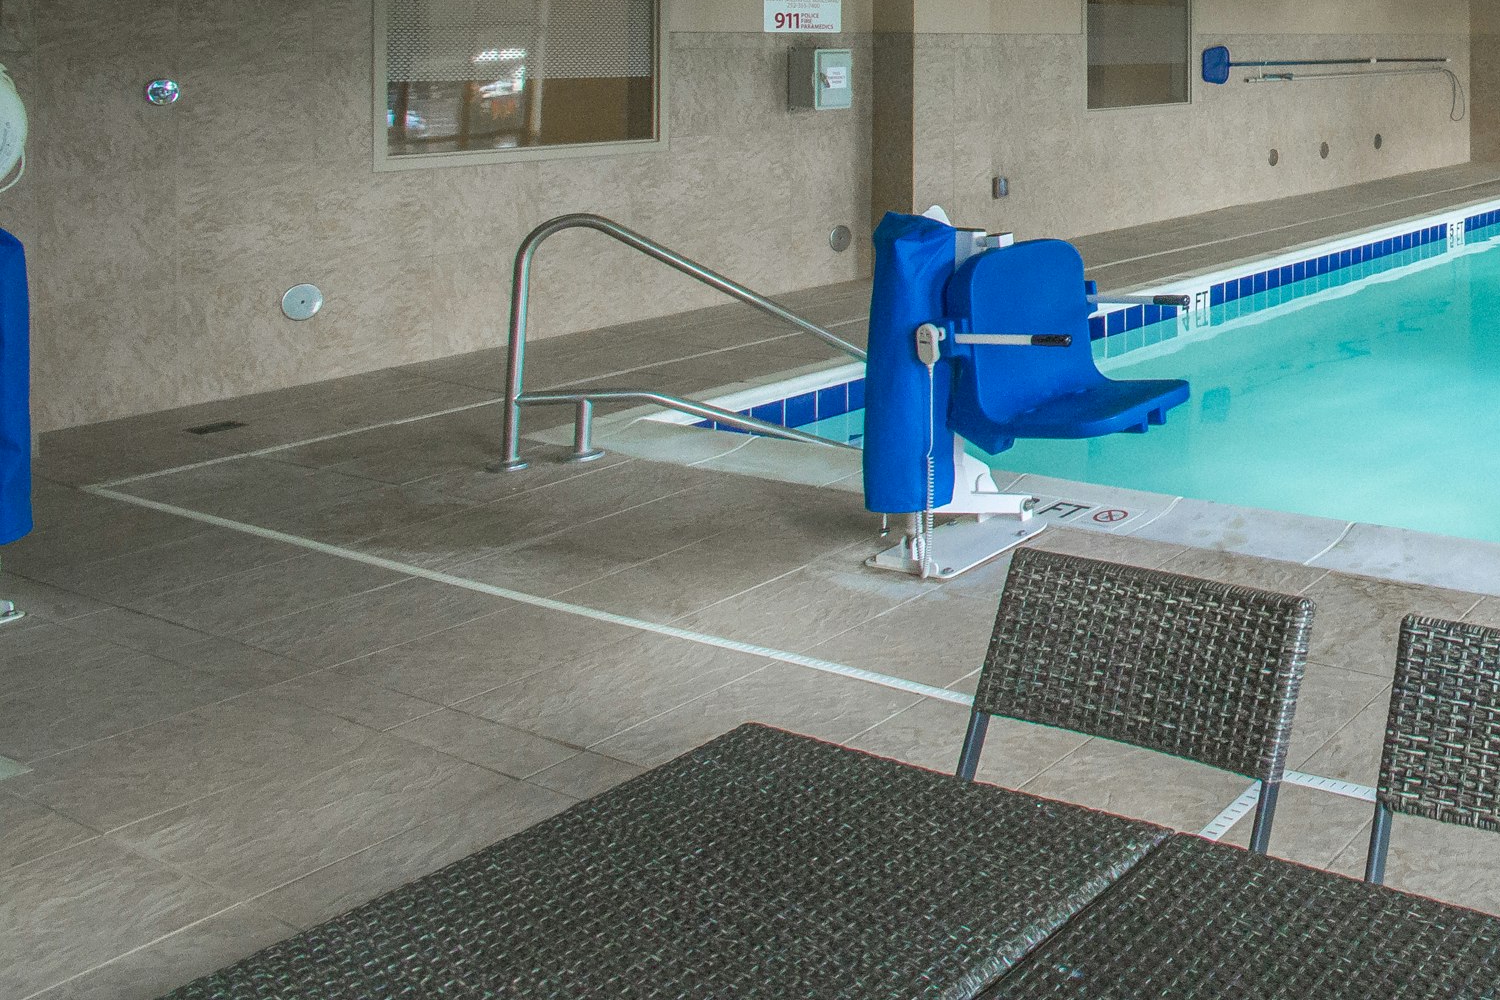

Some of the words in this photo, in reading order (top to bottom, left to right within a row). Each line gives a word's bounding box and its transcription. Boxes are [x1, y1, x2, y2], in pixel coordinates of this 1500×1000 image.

[775, 12, 799, 29] 911
[1195, 290, 1208, 310] FT
[1037, 501, 1091, 519] FT
